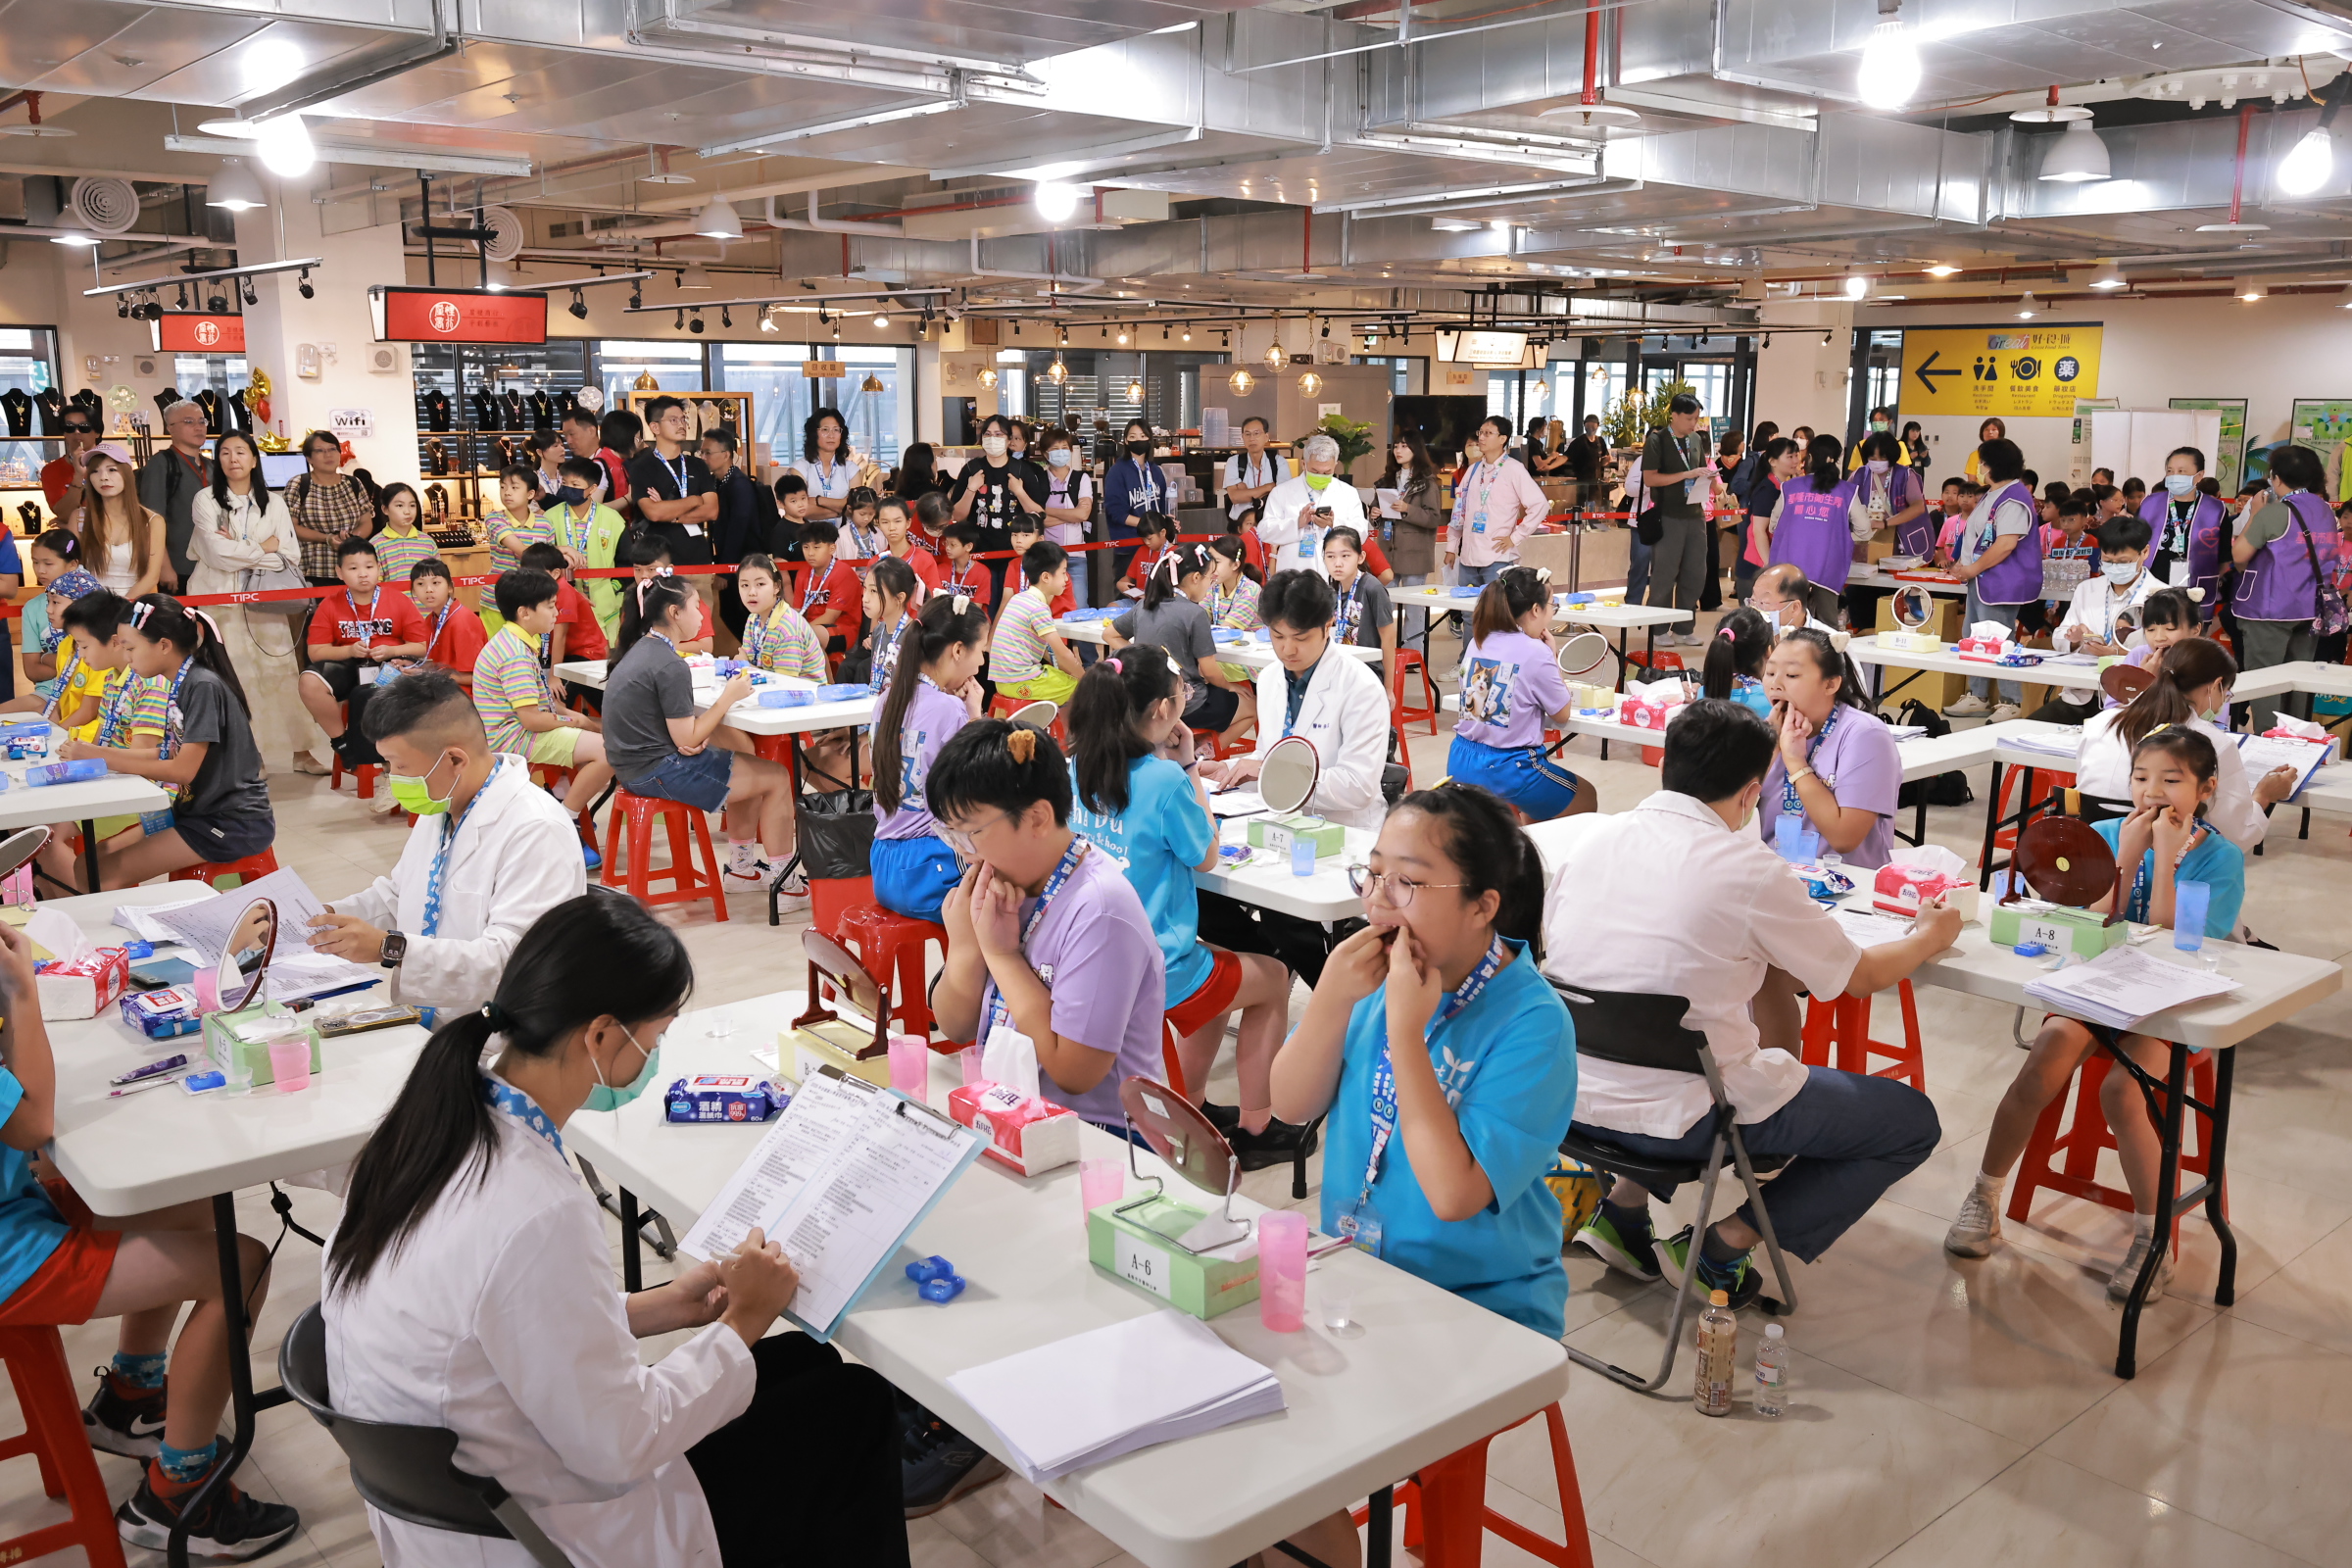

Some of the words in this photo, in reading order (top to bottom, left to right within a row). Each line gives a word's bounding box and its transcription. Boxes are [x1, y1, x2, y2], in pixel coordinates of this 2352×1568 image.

[1988, 334, 2030, 349] Great
[335, 416, 365, 425] Wifi
[461, 576, 485, 586] TIPC
[1272, 832, 1284, 843] A-7
[1097, 833, 1128, 857] School
[2035, 927, 2055, 941] A-8
[805, 1062, 816, 1075] B-
[699, 1101, 722, 1111] 酒精
[1131, 1253, 1152, 1276] A-6
